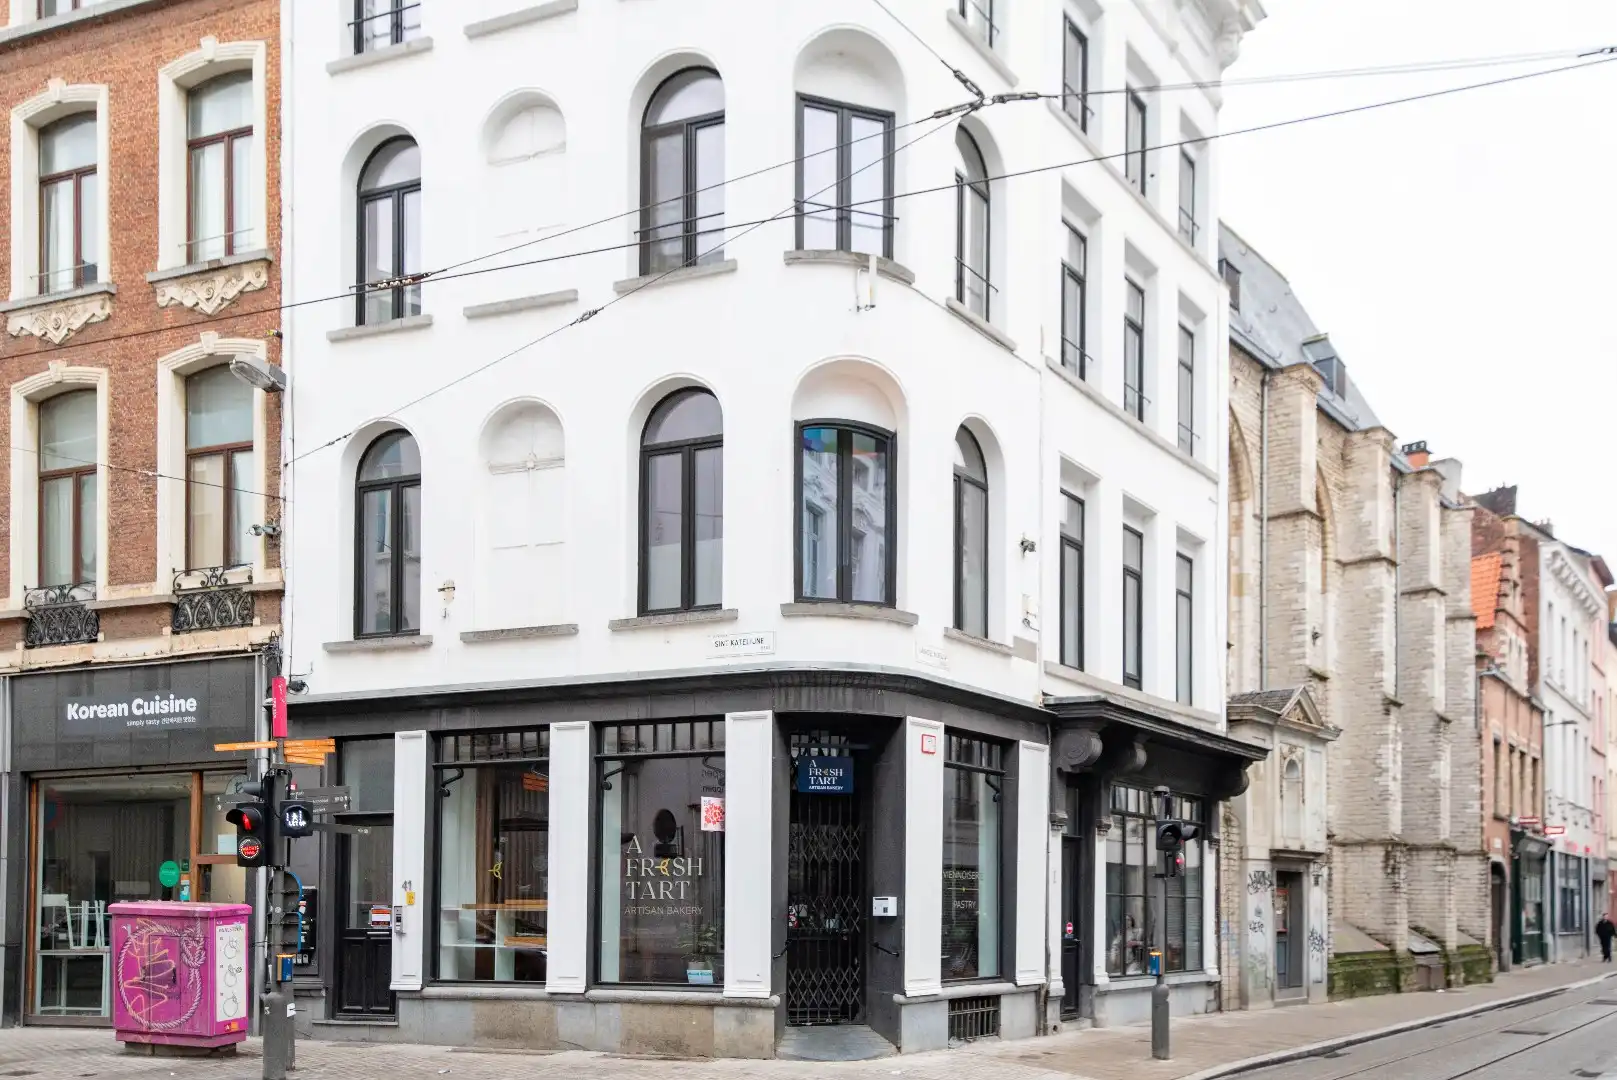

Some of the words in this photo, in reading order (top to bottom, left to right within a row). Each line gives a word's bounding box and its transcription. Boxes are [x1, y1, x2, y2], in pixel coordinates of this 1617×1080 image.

[67, 702, 129, 721] Korean
[131, 693, 198, 716] Cuisine
[126, 719, 145, 727] simply
[145, 718, 160, 726] tasty
[809, 759, 817, 768] A
[808, 776, 838, 785] TART
[626, 834, 642, 854] A
[401, 879, 412, 892] 41
[625, 880, 691, 900] TART
[953, 900, 977, 909] PASTRY
[624, 905, 664, 915] ARTISAN
[666, 905, 704, 915] BAKERY
